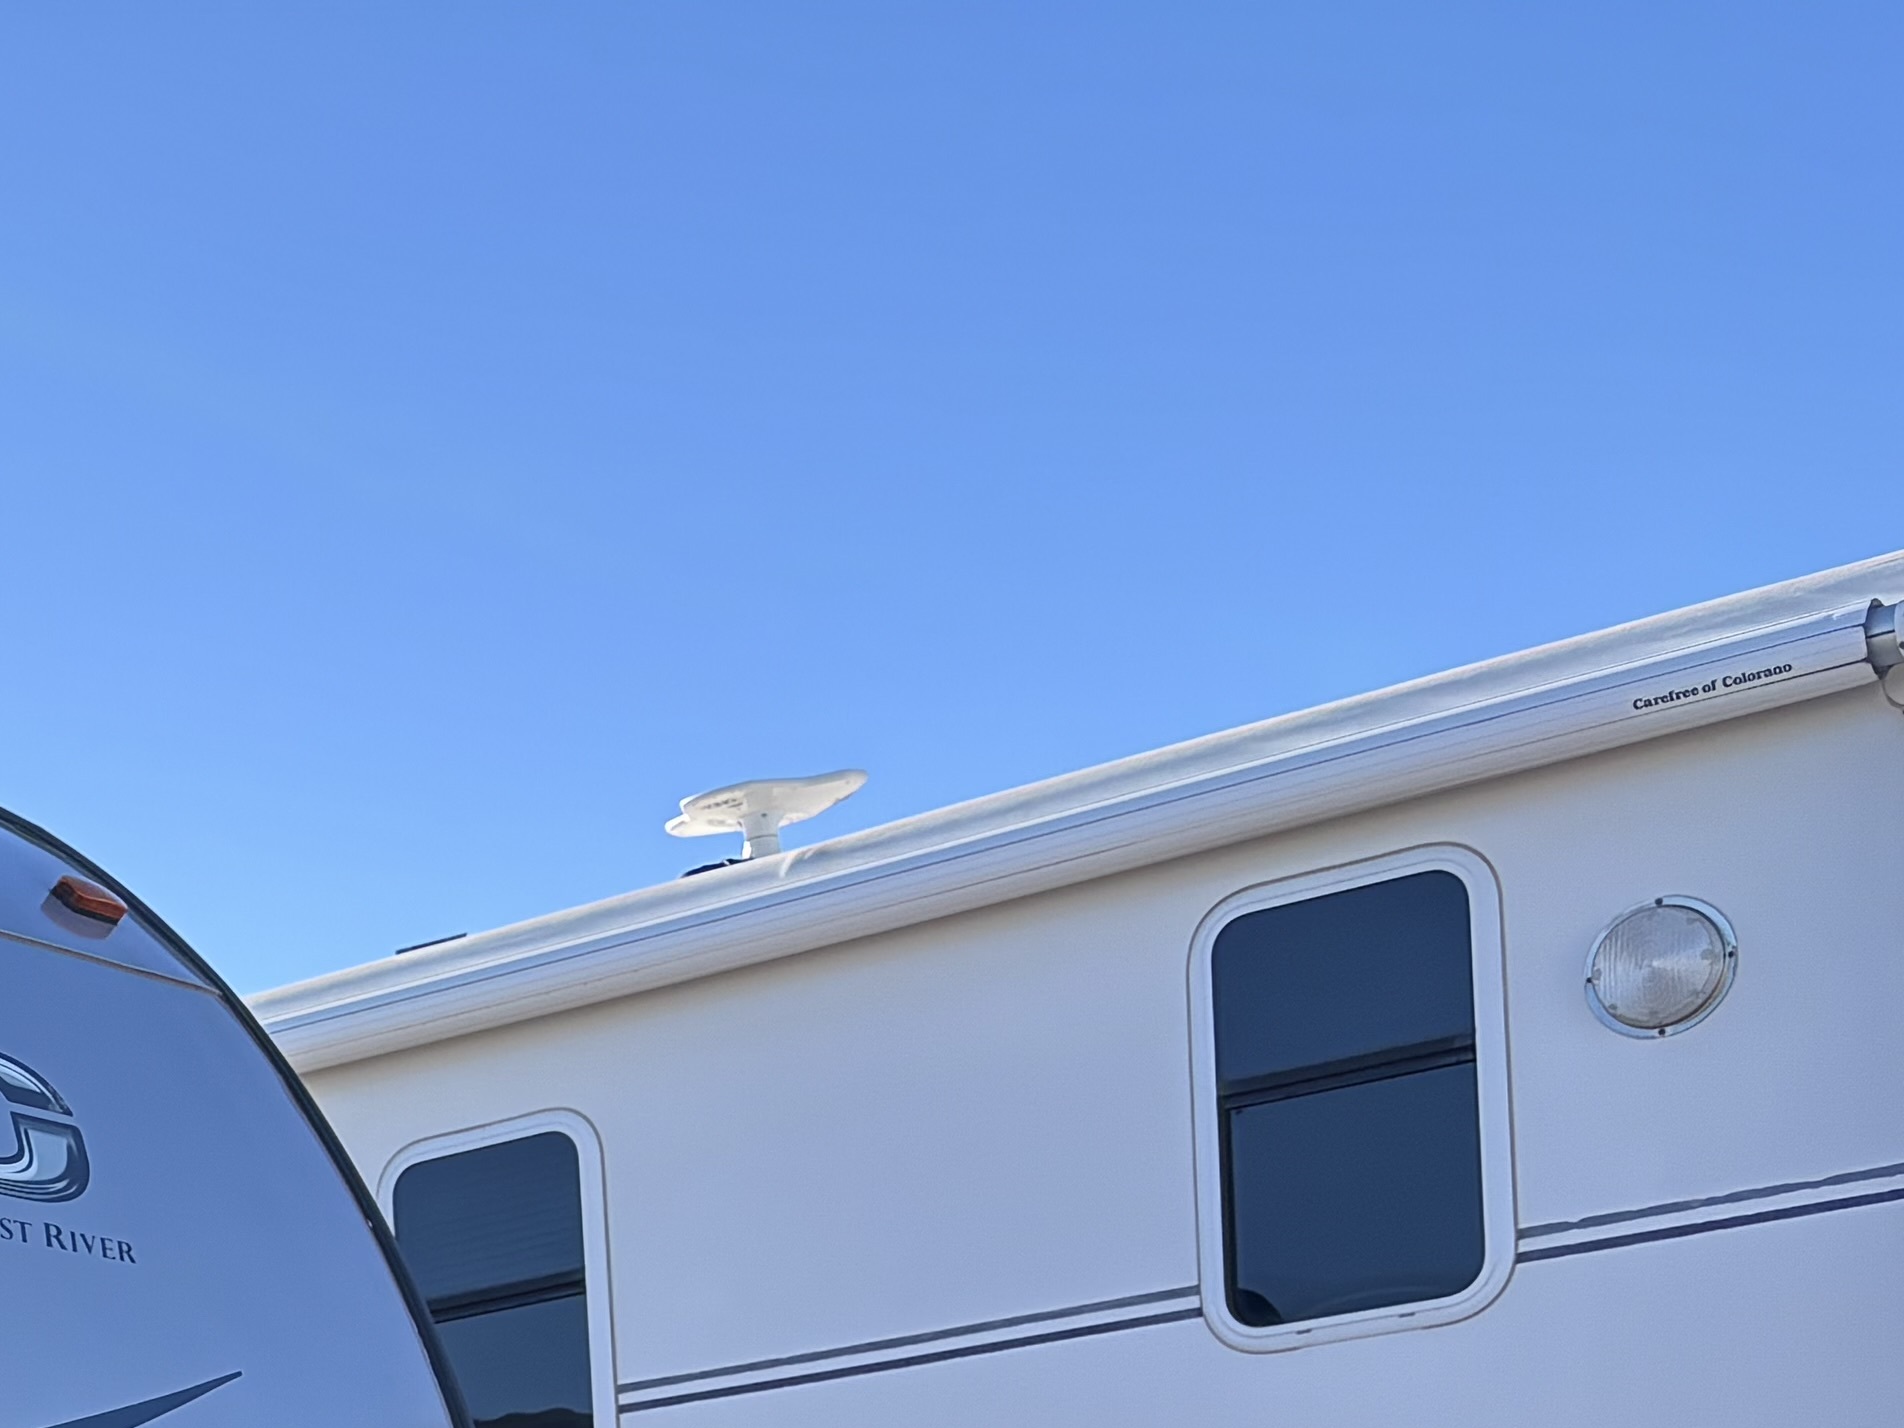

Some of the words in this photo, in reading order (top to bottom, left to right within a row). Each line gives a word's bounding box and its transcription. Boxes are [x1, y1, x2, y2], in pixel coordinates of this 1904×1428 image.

[1633, 686, 1700, 711] Carefree
[1702, 679, 1719, 694] of
[43, 1222, 138, 1264] RIVER
